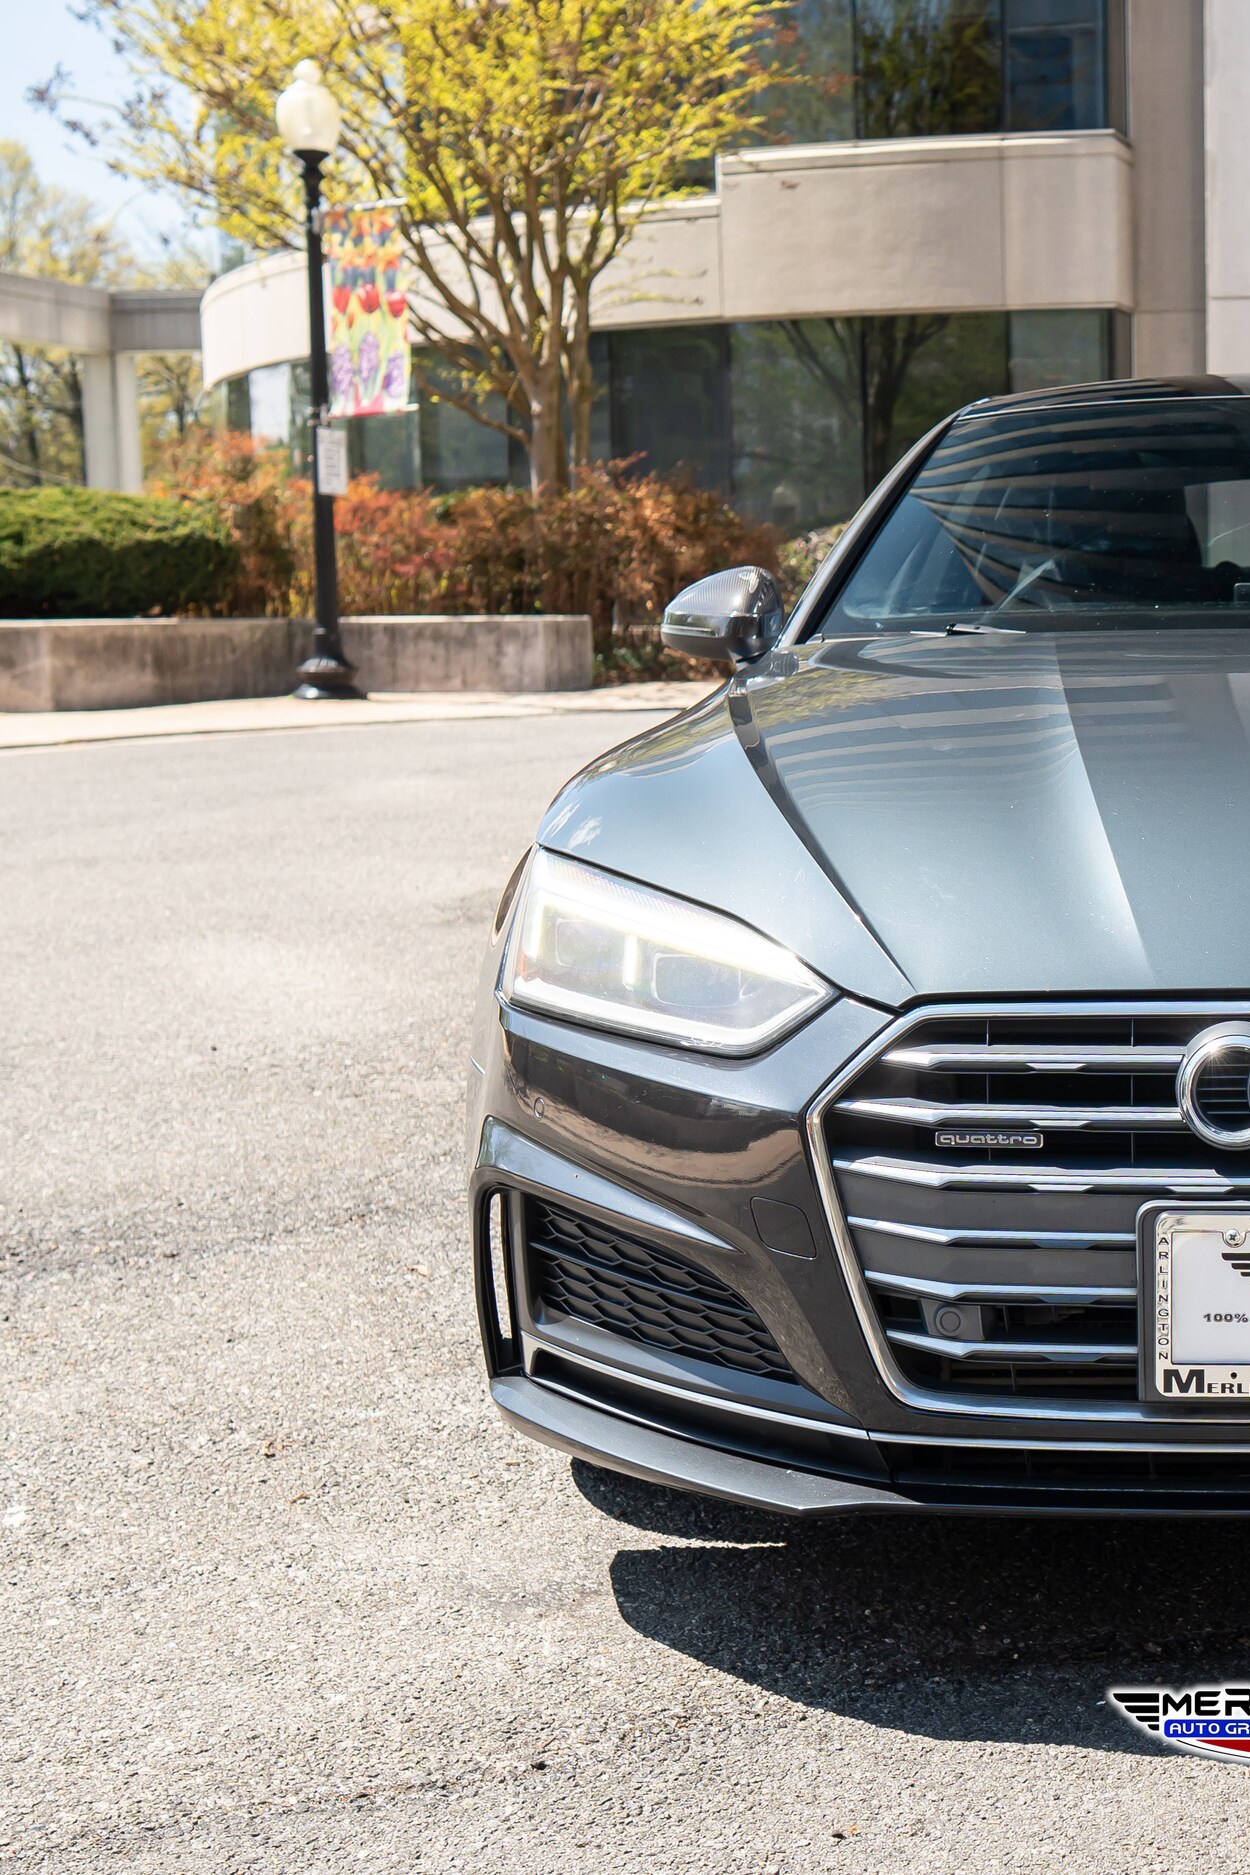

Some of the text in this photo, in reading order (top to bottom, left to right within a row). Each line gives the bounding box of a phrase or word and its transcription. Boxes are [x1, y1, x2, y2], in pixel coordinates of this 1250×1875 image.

[940, 1134, 1038, 1145] quattro
[1158, 1237, 1169, 1360] ARLINGTON
[1203, 1313, 1248, 1323] 100%
